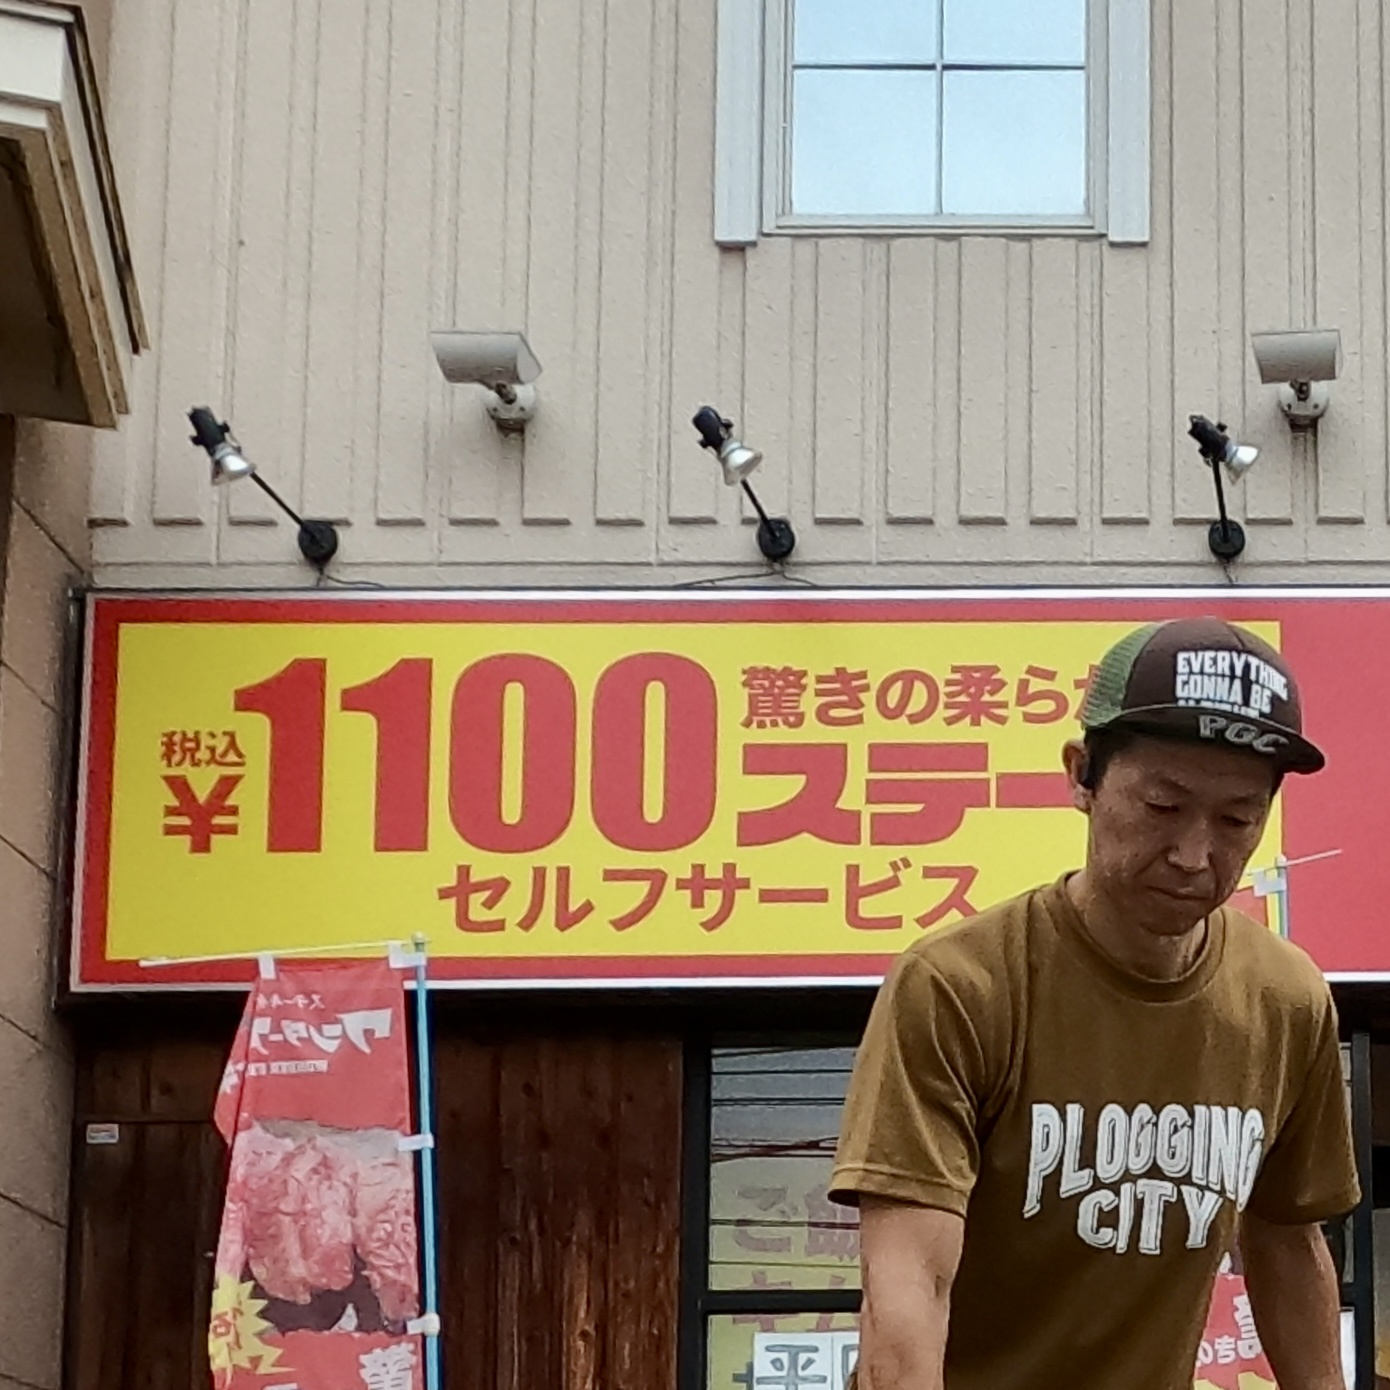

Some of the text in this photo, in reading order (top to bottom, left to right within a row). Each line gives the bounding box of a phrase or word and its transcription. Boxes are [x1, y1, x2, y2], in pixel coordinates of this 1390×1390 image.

[1176, 674, 1243, 705] GONNA
[1250, 683, 1272, 714] BE
[1177, 651, 1287, 701] EVERYTHING
[161, 731, 247, 769] 税込
[437, 859, 980, 933] セルフサービス
[1024, 1103, 1266, 1218] PLOGGING
[1078, 1178, 1224, 1255] CITY
